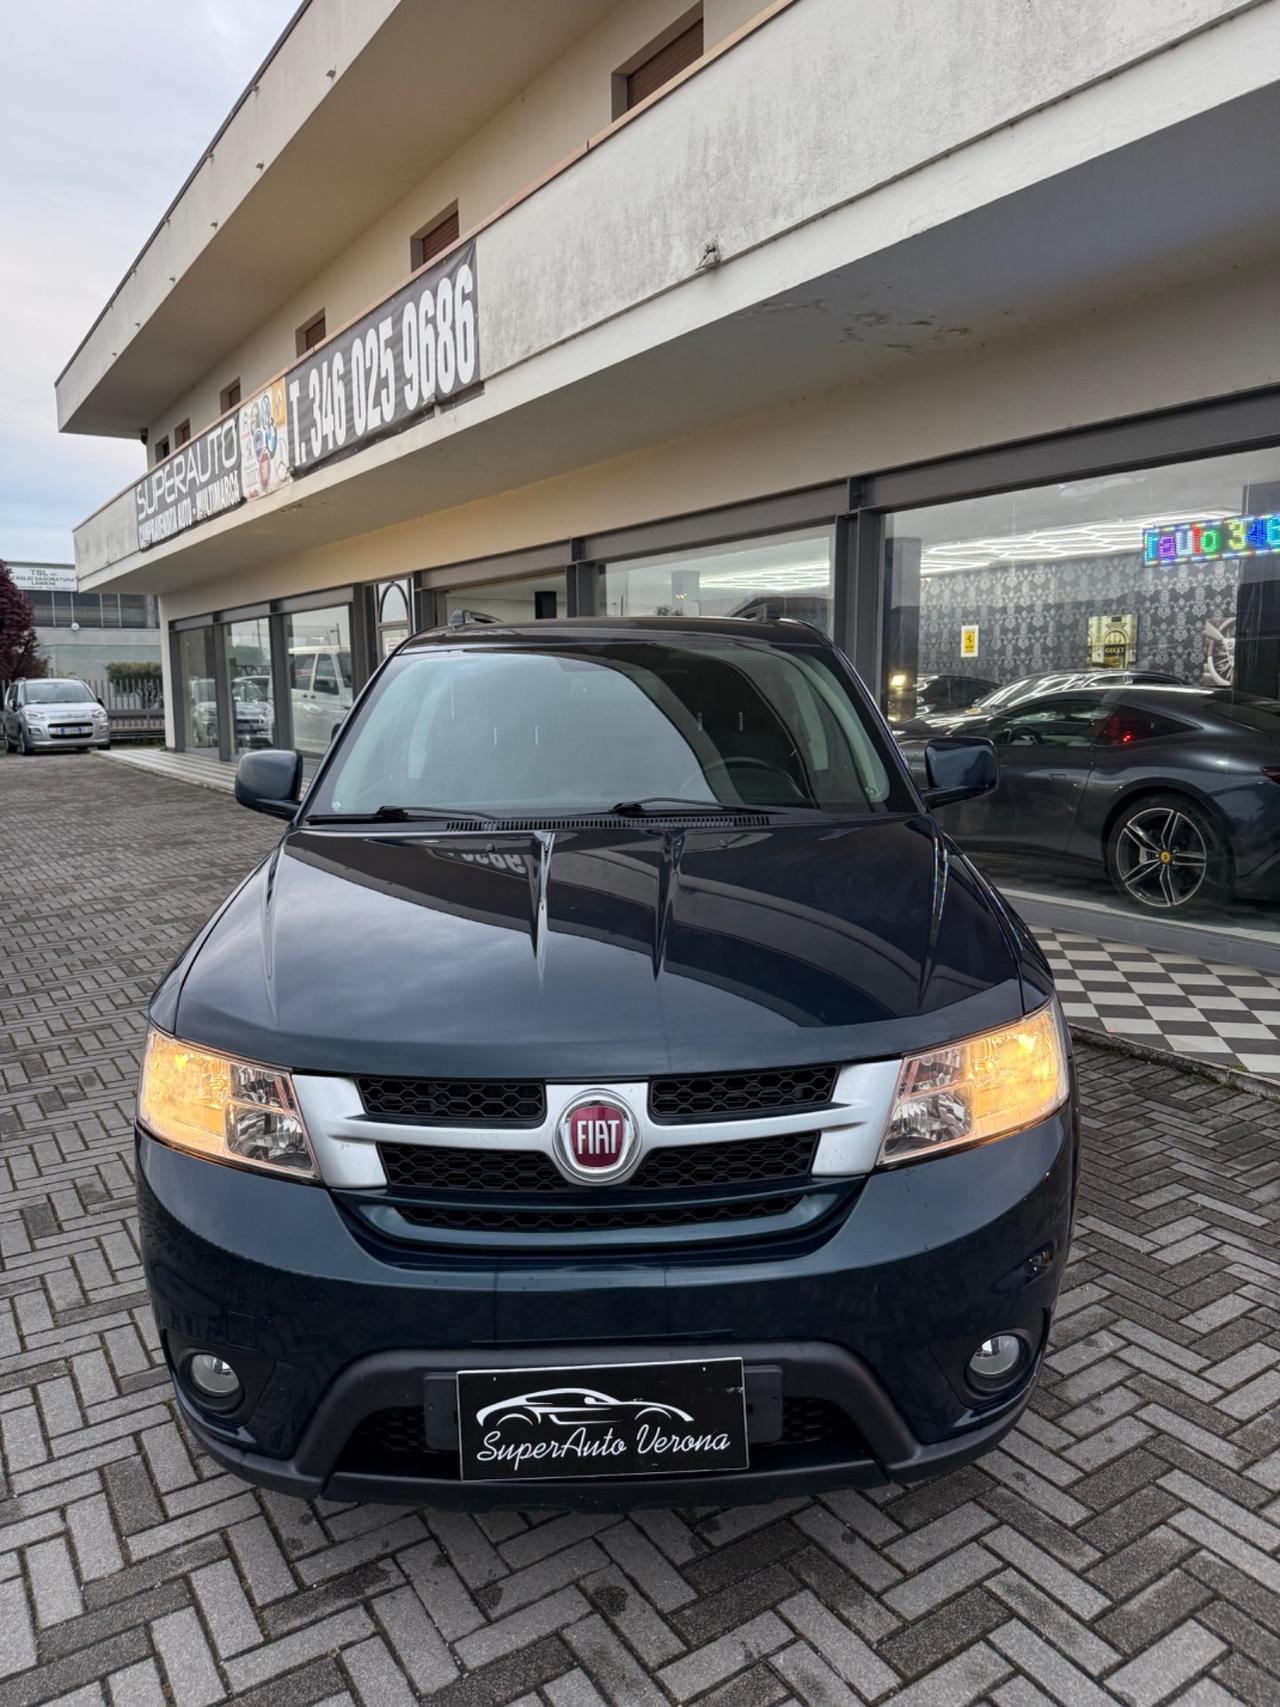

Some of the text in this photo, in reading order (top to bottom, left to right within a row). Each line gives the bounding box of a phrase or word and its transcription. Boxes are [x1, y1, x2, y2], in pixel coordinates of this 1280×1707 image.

[289, 264, 475, 466] T. 346 025 9686
[136, 418, 238, 520] SUPERAUTO
[577, 1120, 619, 1155] FIAT
[477, 1424, 731, 1471] SuperAuto Verona
